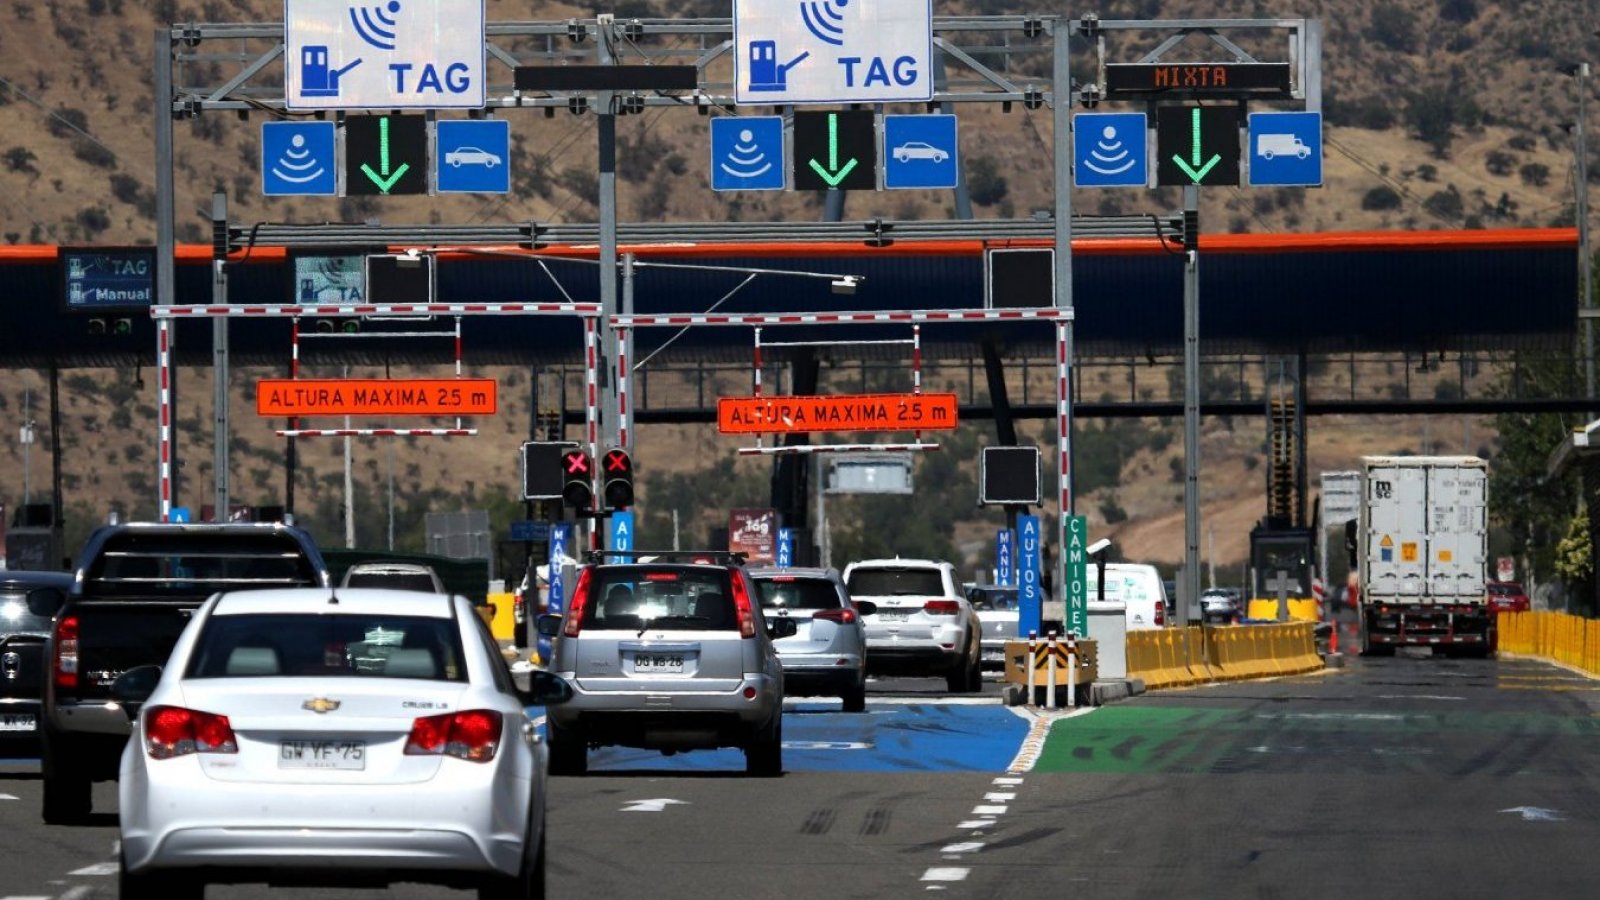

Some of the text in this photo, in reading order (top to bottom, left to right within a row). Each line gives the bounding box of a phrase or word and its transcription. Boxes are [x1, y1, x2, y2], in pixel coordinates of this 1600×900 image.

[388, 62, 470, 94] TAG
[837, 55, 918, 88] TAG
[1155, 66, 1227, 87] MIXTA
[112, 260, 148, 275] TAG
[95, 288, 150, 301] Manual
[269, 388, 345, 408] ALTURA
[353, 388, 430, 407] MAXIMA
[471, 391, 487, 406] m
[730, 402, 947, 425] ALTURA MAXIMA 2.5 m
[552, 529, 564, 600] MANUAL
[1023, 521, 1035, 598] AUTOS
[1070, 519, 1083, 636] CAMIONES
